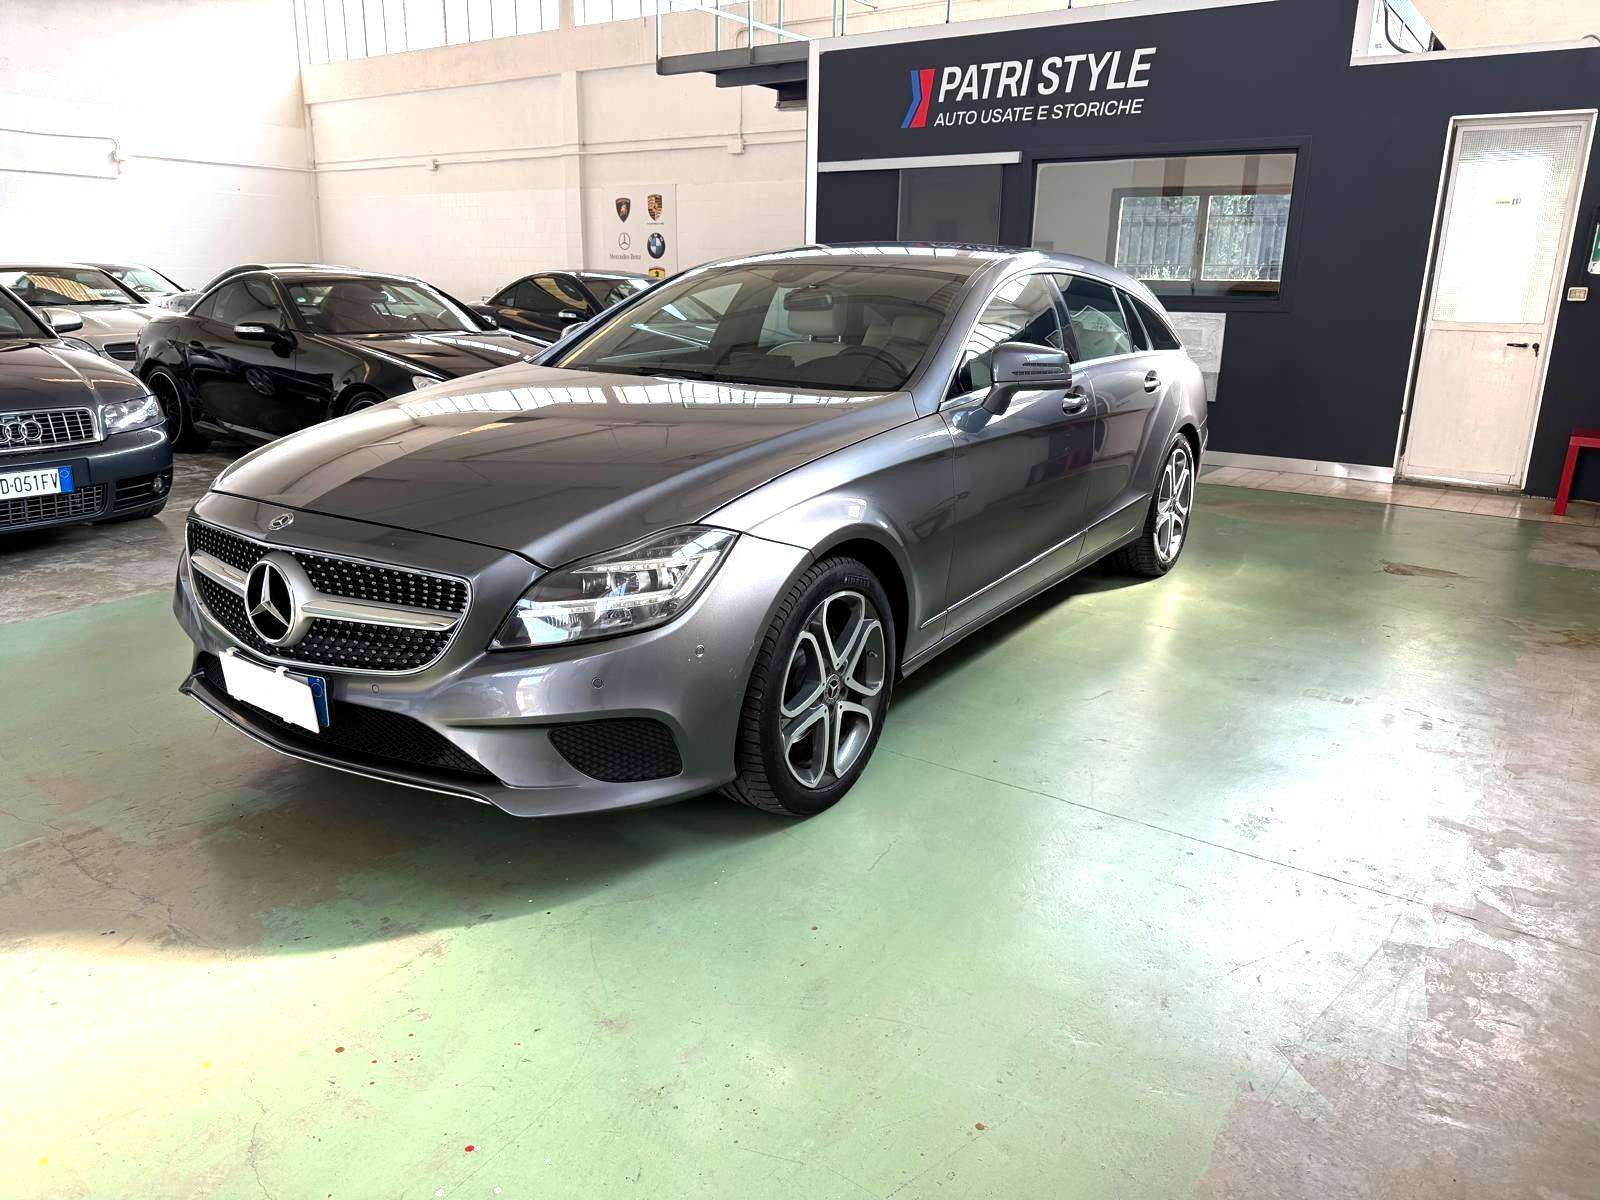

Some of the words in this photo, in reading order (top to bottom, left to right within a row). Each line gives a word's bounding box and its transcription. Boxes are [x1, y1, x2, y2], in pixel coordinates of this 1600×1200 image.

[938, 58, 1034, 103] PATRI
[1037, 47, 1157, 96] STYLE
[934, 110, 978, 127] AUTO
[981, 106, 1034, 123] USATE
[1036, 105, 1050, 121] E
[1051, 98, 1145, 120] STORICHE
